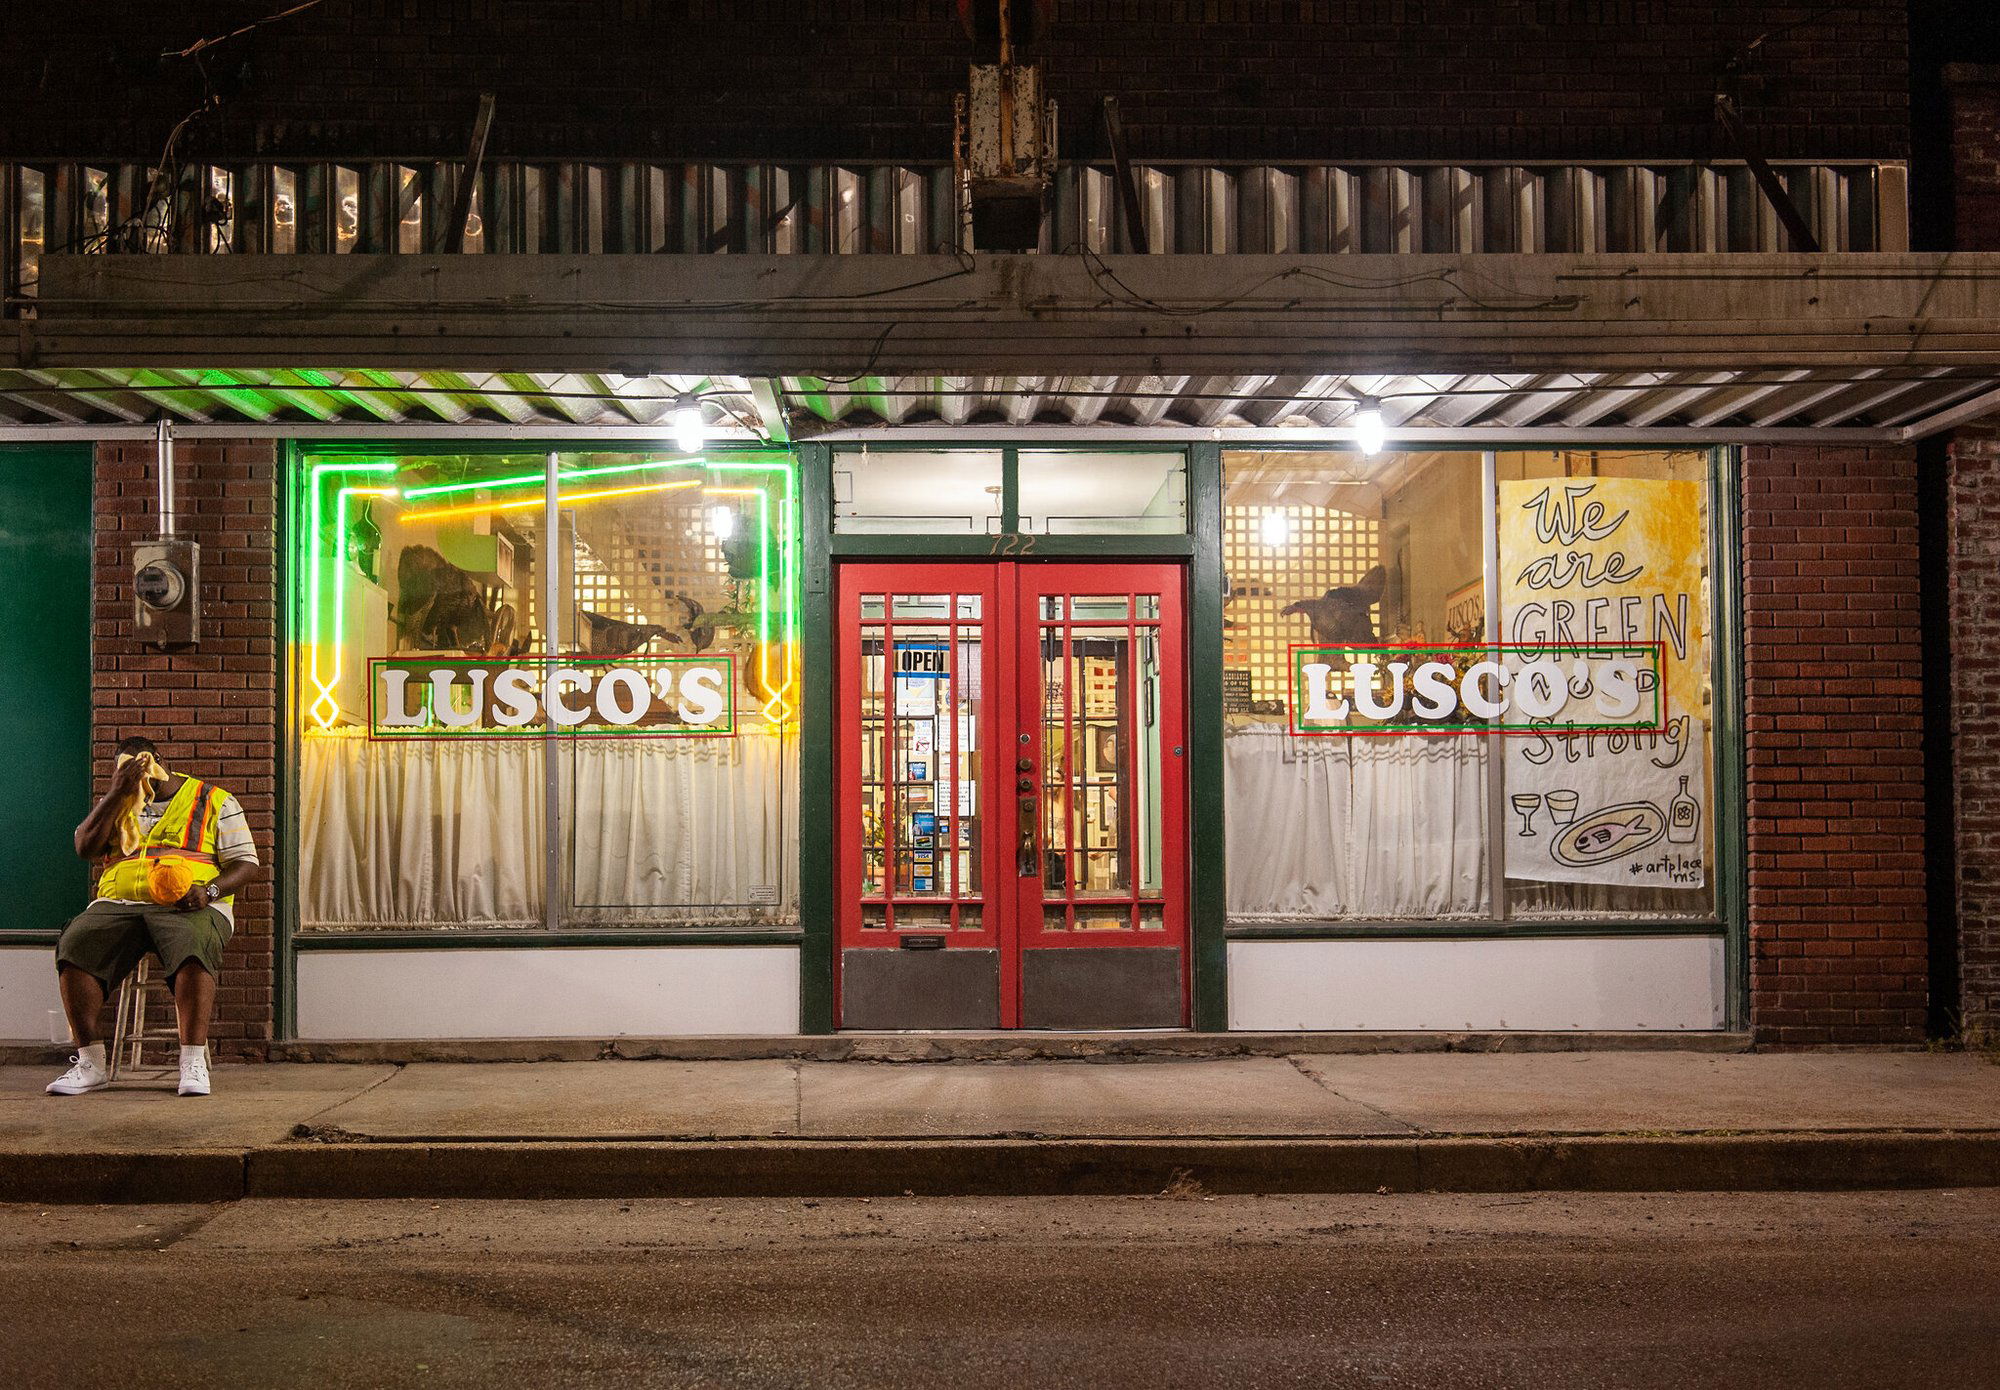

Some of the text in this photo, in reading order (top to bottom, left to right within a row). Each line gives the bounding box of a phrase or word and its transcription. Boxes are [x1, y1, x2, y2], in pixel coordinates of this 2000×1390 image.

[1522, 484, 1629, 546] We
[990, 533, 1036, 555] 722
[1515, 551, 1643, 590] are
[1513, 593, 1687, 664] GREEN
[902, 651, 944, 671] OPEN
[380, 667, 724, 727] LUSCO'S
[1301, 660, 1640, 719] LUSCO'S
[1522, 715, 1690, 768] Strong
